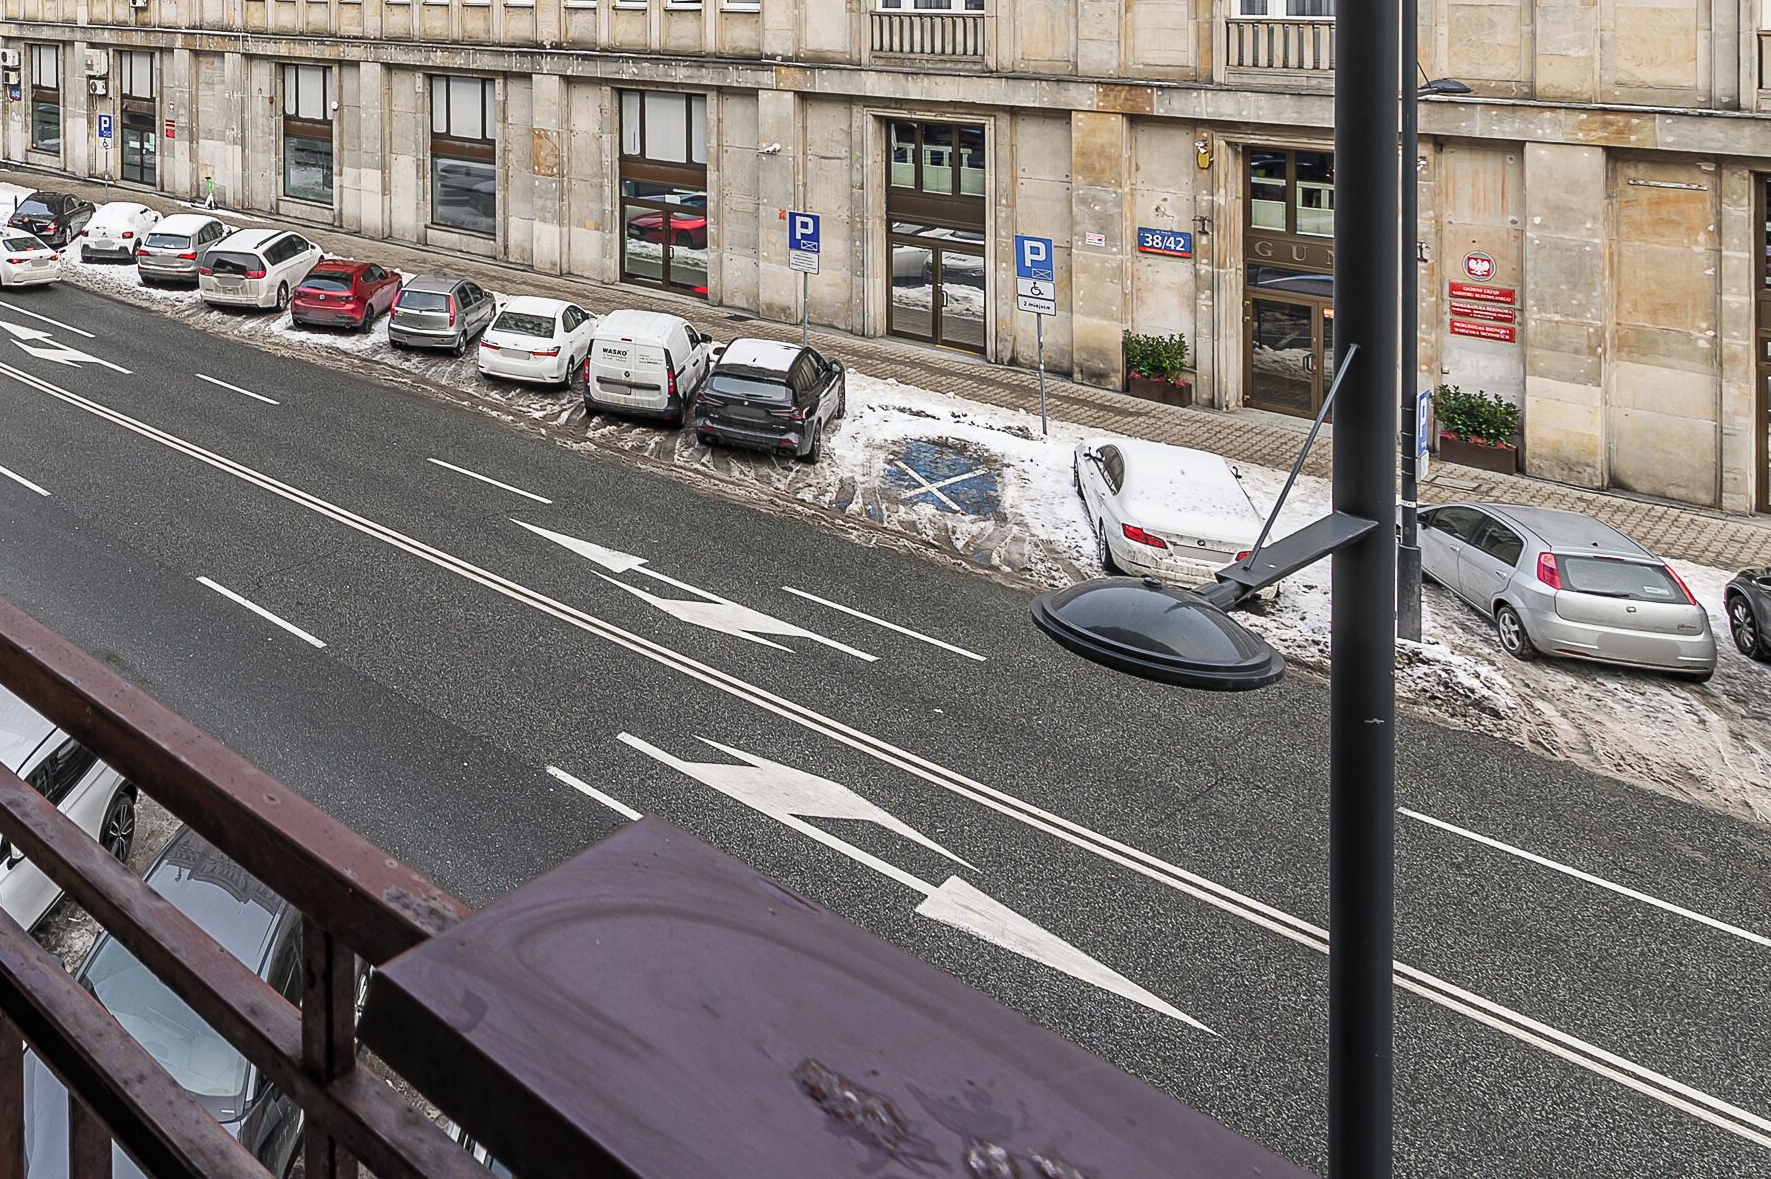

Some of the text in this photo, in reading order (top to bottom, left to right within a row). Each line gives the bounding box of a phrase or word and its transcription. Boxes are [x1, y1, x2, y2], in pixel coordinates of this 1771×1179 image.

[101, 116, 110, 131] P
[795, 215, 814, 240] P
[1143, 233, 1185, 251] 38/42
[1023, 239, 1047, 268] P
[602, 347, 628, 357] WASKO
[1419, 396, 1428, 438] P
